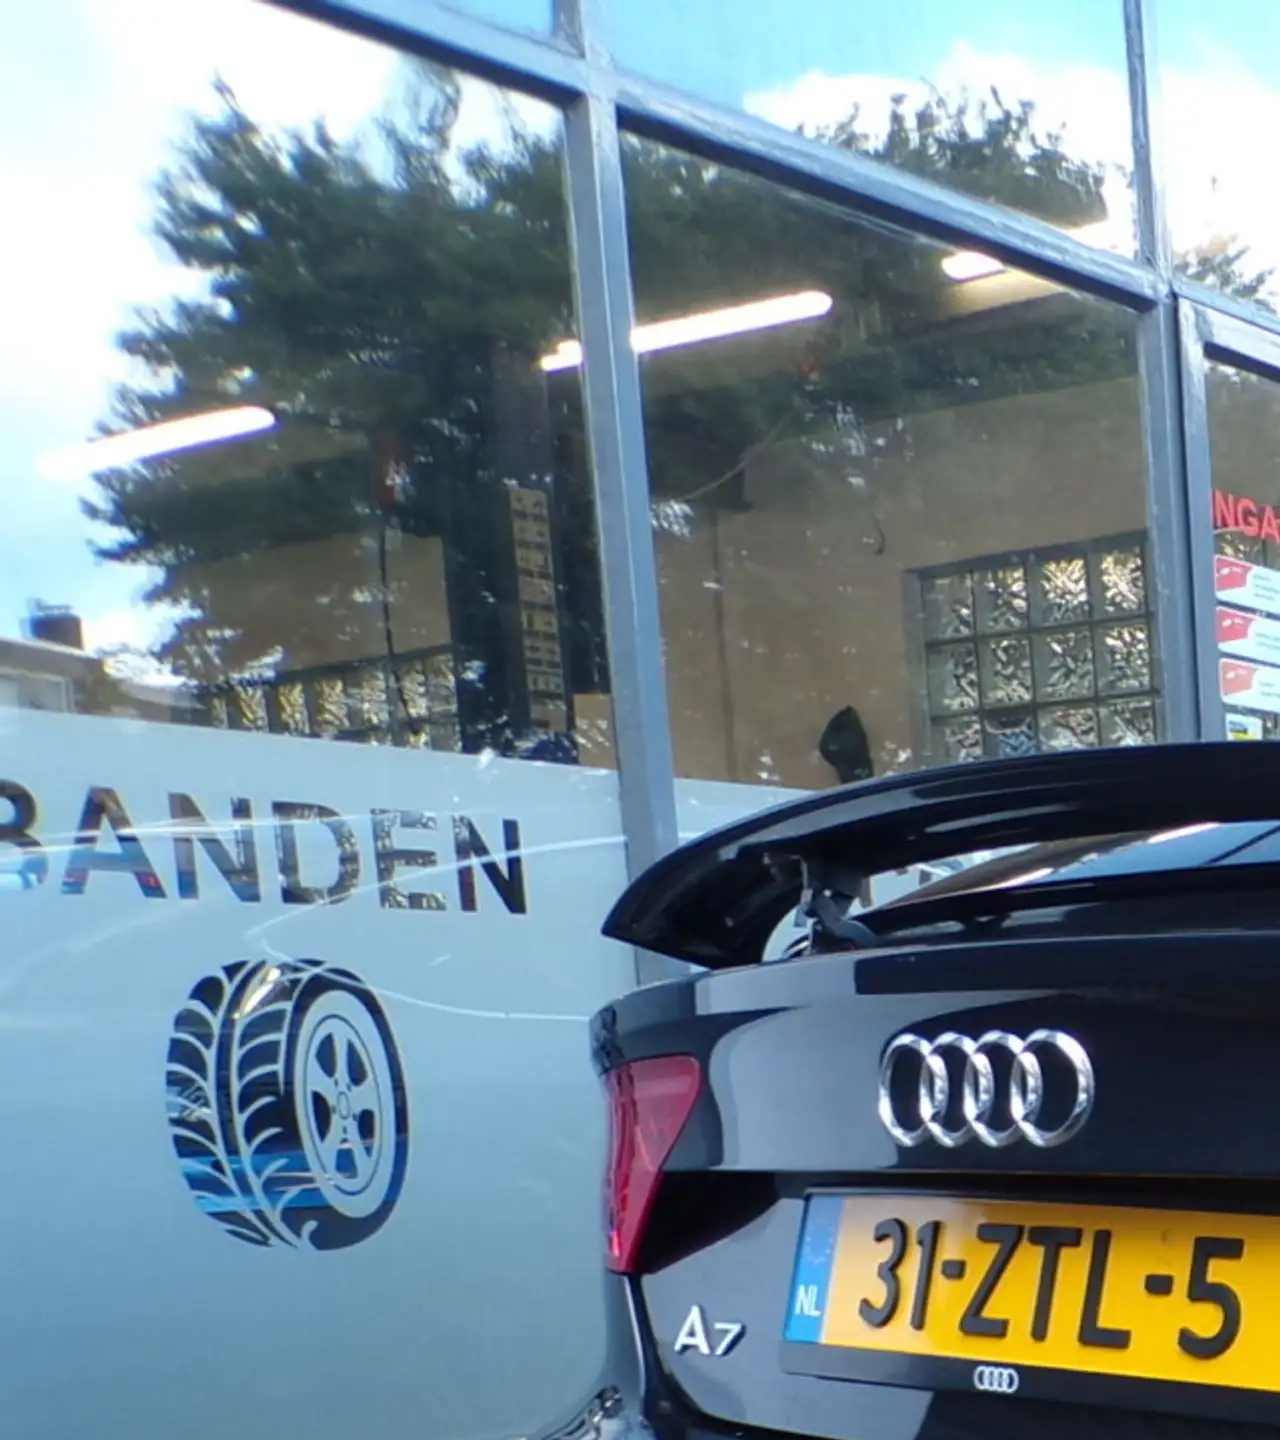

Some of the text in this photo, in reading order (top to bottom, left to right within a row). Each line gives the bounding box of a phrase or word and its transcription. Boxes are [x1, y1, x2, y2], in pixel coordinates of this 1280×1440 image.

[0, 778, 528, 914] BANDEN
[674, 1304, 746, 1356] A7
[794, 1283, 821, 1317] NL
[858, 1217, 1246, 1361] 31-ZTL-5
